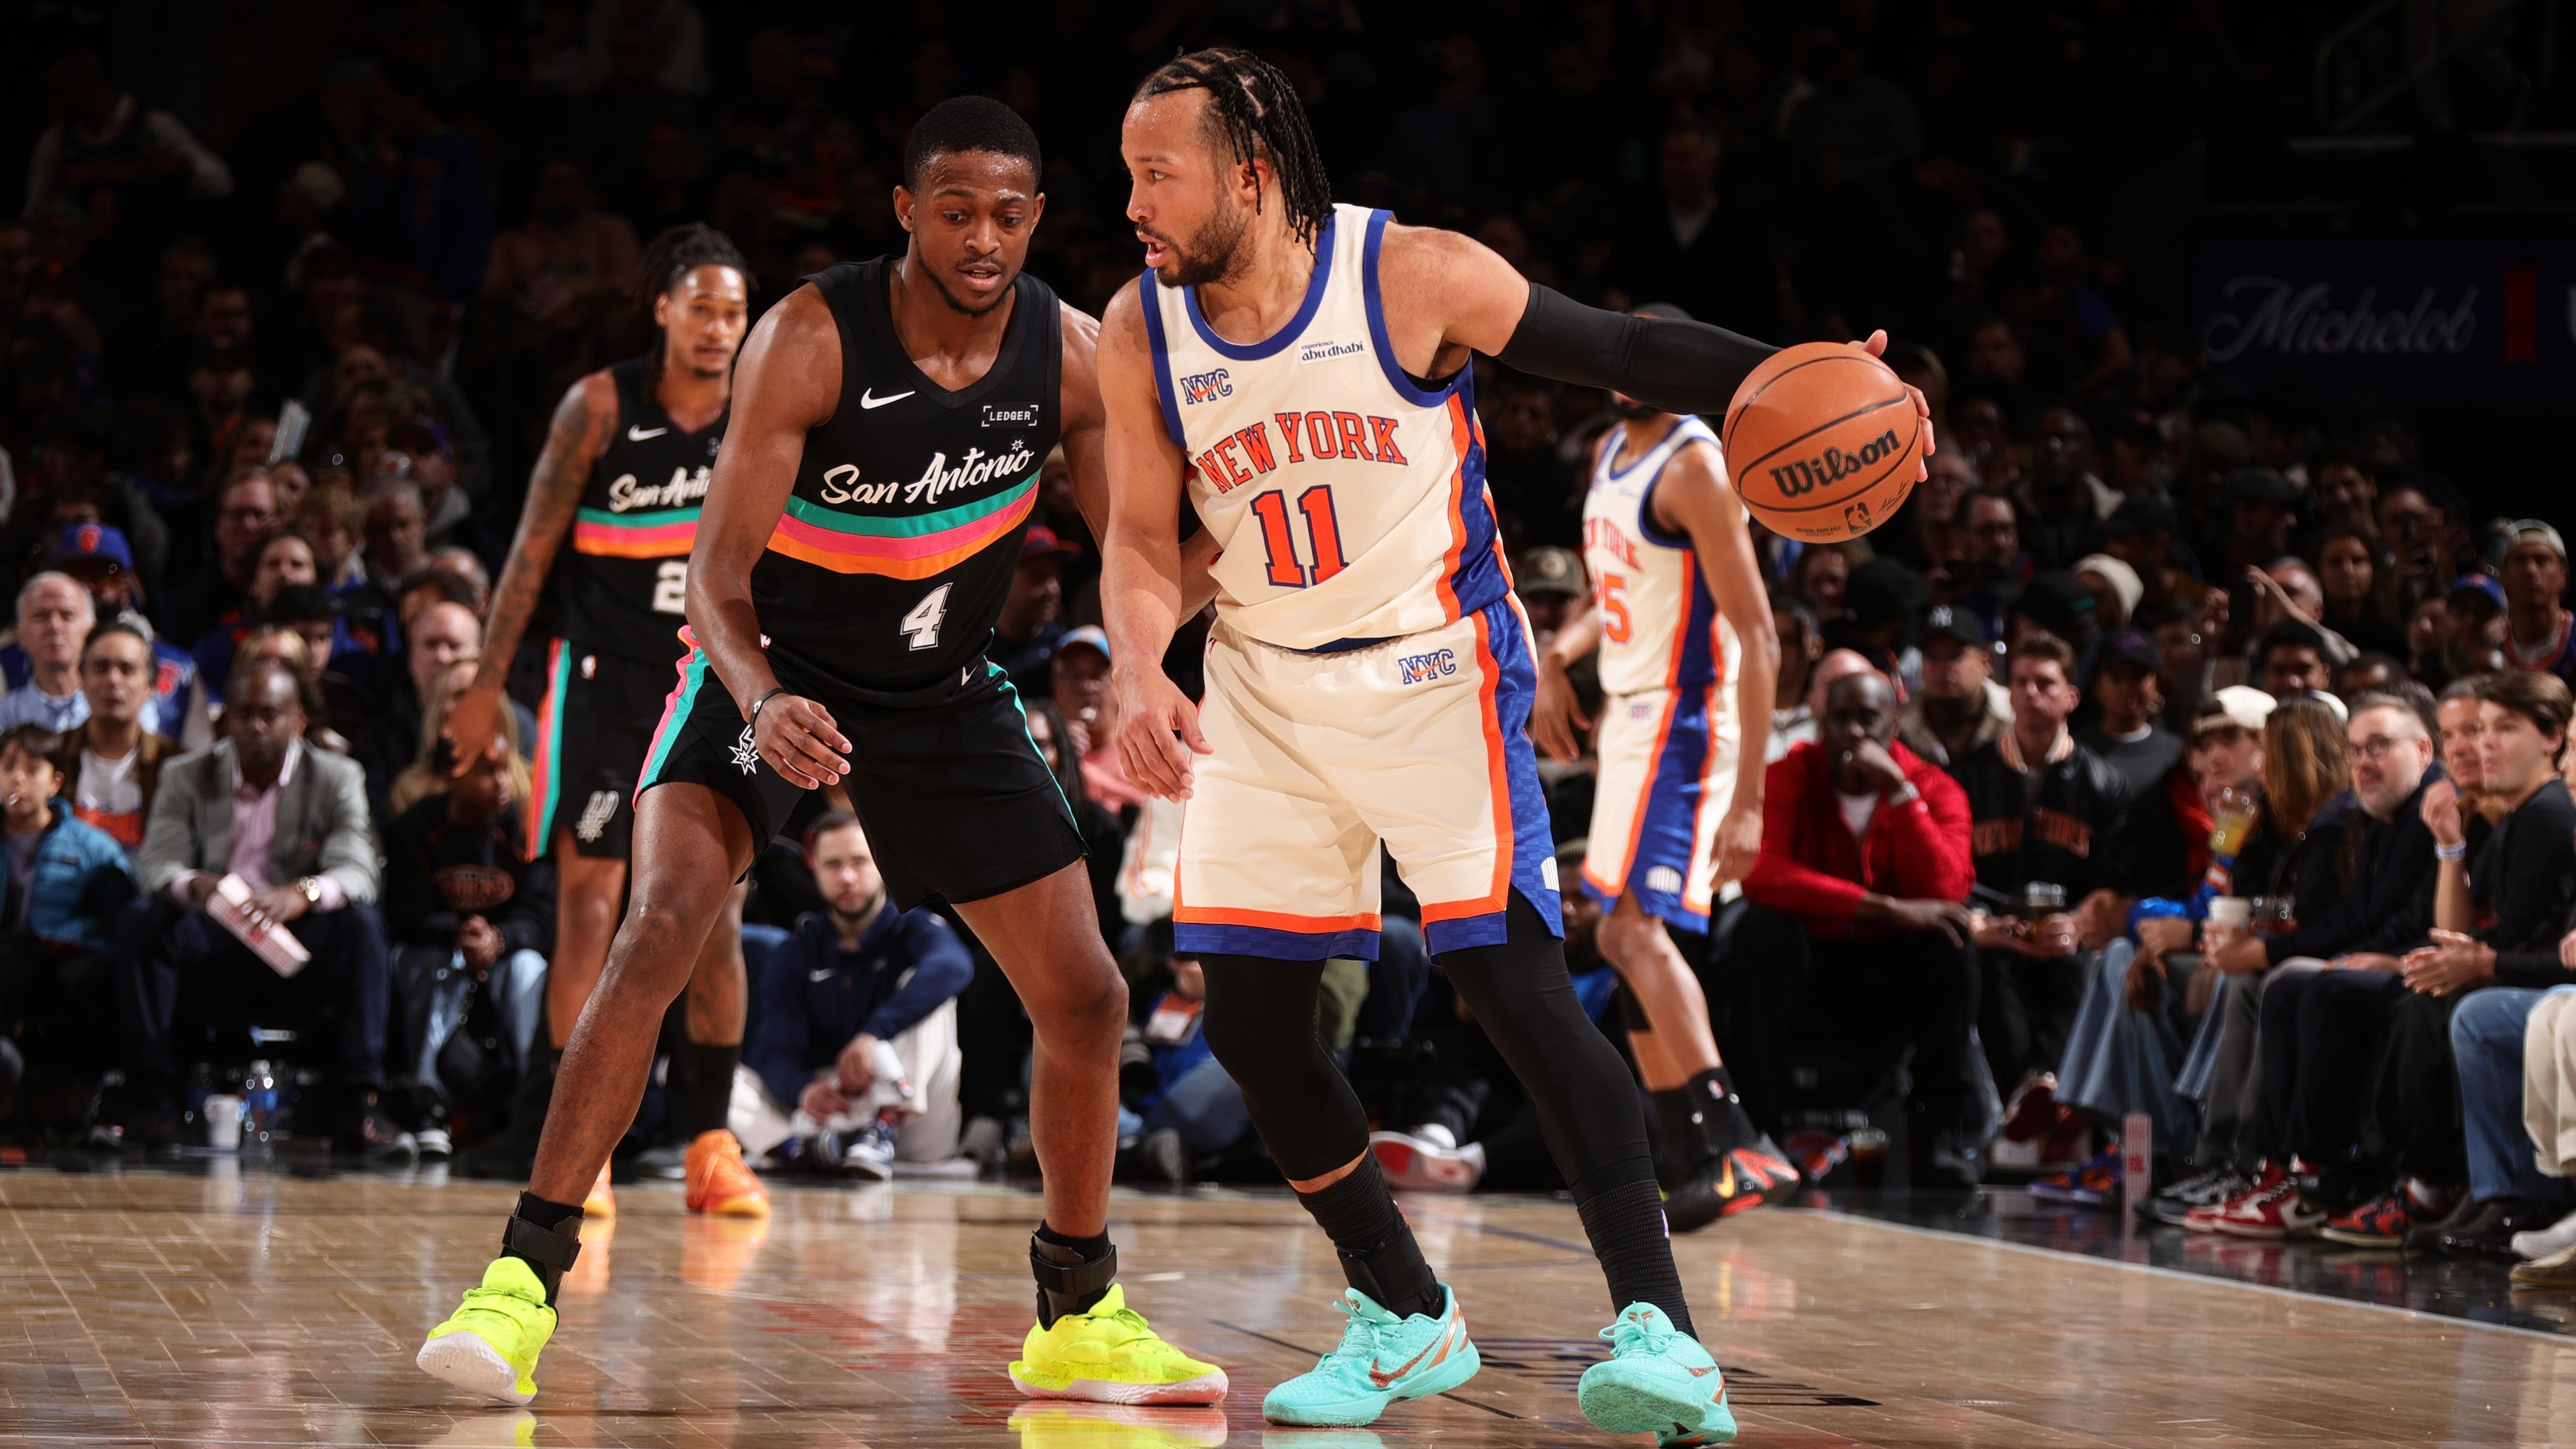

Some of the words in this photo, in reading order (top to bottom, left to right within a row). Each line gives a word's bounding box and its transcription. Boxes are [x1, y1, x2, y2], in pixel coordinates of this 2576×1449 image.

[2200, 275, 2480, 363] Michelob
[1301, 341, 1334, 349] experience
[1302, 350, 1326, 361] abu
[1328, 341, 1364, 356] dhabi
[1179, 368, 1233, 405] NYC
[990, 411, 1031, 421] LEDGER
[821, 464, 899, 504] San
[904, 439, 1034, 504] Antonio
[1196, 422, 1277, 494] NEW
[1275, 411, 1408, 466] YORK
[1769, 428, 1902, 498] Wilson
[609, 474, 660, 512] San
[1250, 484, 1350, 589] 11
[900, 582, 954, 651] 4
[1398, 648, 1457, 685] NYC
